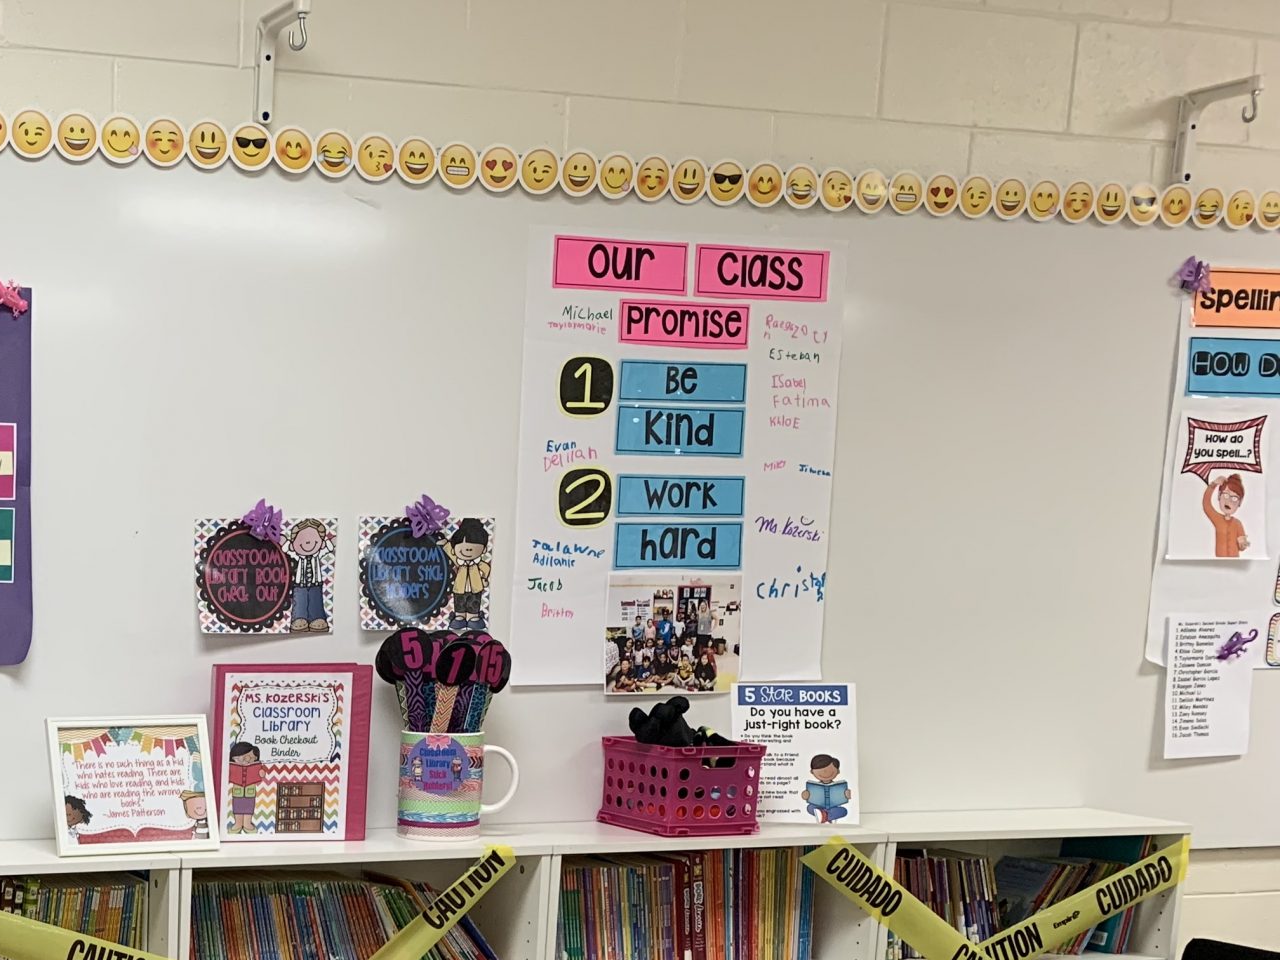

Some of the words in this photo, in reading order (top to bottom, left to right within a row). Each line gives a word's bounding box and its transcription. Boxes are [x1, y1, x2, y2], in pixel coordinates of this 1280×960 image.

[562, 304, 613, 322] Michael
[566, 362, 606, 409] 1
[1230, 434, 1244, 444] do
[1194, 449, 1214, 460] you
[565, 473, 606, 519] 2
[400, 631, 424, 669] 5
[447, 648, 465, 684] 1
[480, 645, 504, 684] 15
[744, 687, 756, 702] 5
[799, 690, 841, 703] BOOKS
[750, 707, 766, 717] Do
[770, 708, 791, 719] you
[794, 706, 825, 717] have
[828, 708, 836, 717] a
[744, 719, 801, 732] just-right
[804, 719, 842, 730] book?
[254, 735, 279, 745] Book
[280, 734, 319, 745] Checkout
[271, 747, 301, 757] Binder
[94, 768, 115, 779] hates
[421, 849, 507, 930] CAUTION
[826, 847, 903, 917] CUIDADO
[1095, 855, 1173, 916] CUIDADO
